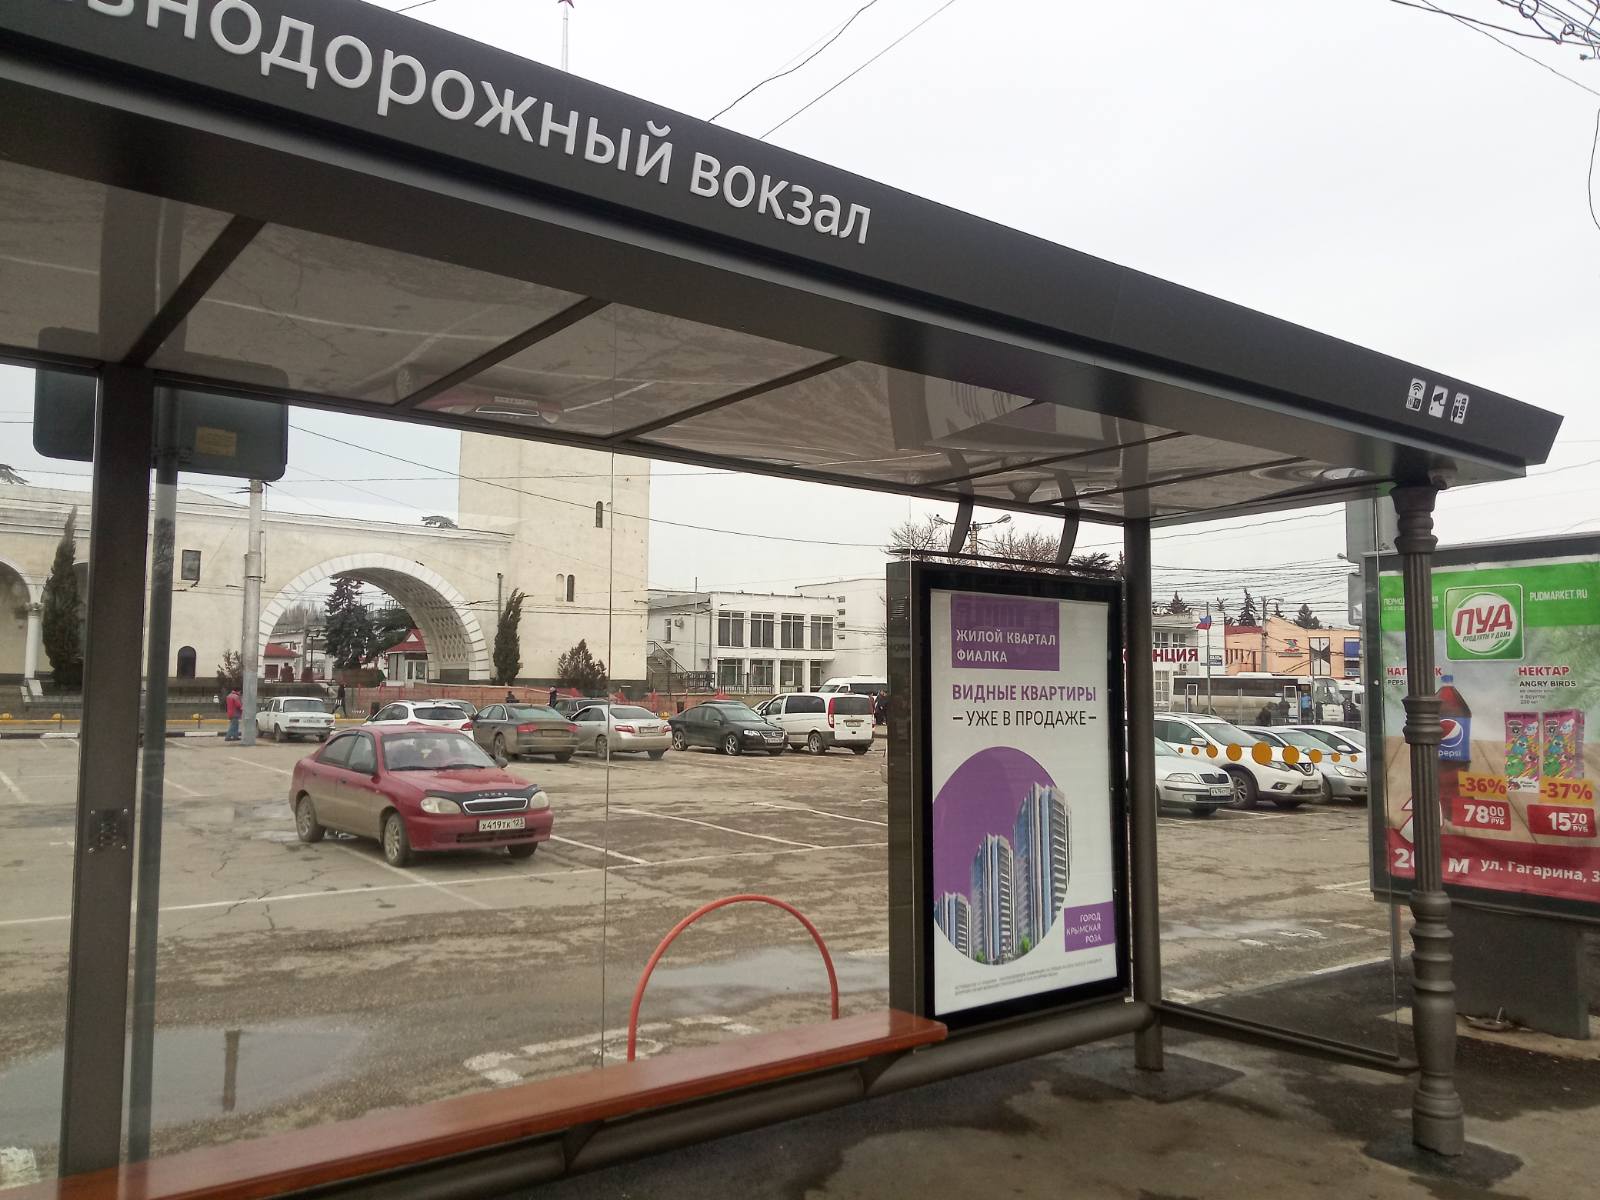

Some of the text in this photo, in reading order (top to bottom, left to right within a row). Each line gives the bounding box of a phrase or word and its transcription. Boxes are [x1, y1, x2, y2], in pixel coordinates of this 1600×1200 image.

[87, 0, 872, 245] нодорожный вокзал
[1455, 603, 1513, 636] ПУД
[956, 629, 1056, 646] ЖИЛОЙ КВАРТАЛ
[957, 649, 1008, 662] ФИАЛКА
[1518, 666, 1569, 676] НЕКТАР
[952, 684, 1096, 703] ВИДНЫЕ КВАРТИРЫ
[966, 711, 1087, 728] УЖЕ В ПРОДАЖЕ
[1459, 777, 1507, 795] -36%
[1540, 782, 1593, 800] -37%
[1480, 859, 1504, 872] ул.
[1508, 861, 1587, 883] Гагарина,
